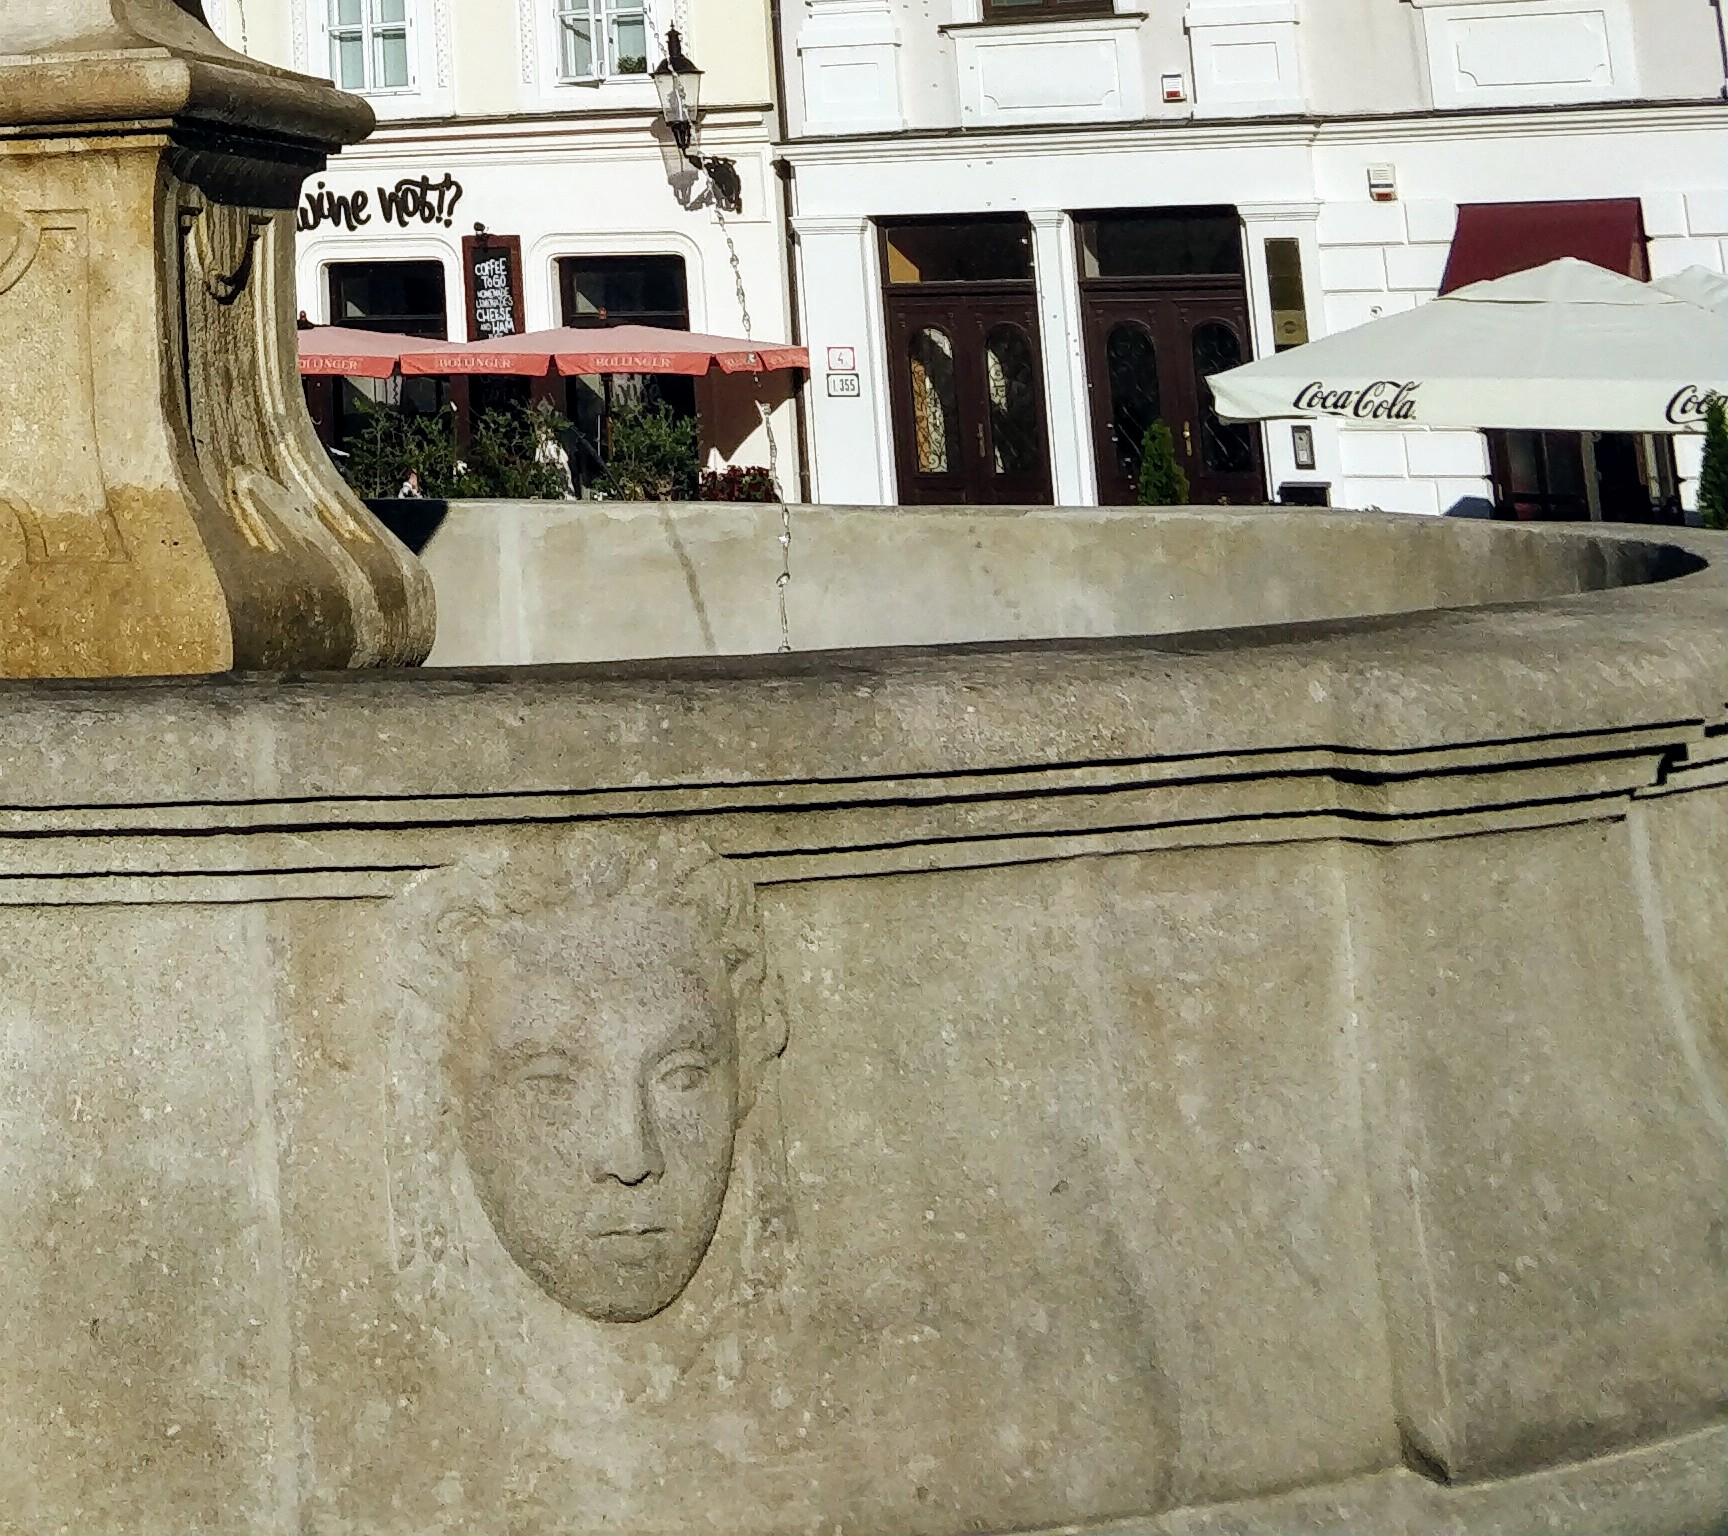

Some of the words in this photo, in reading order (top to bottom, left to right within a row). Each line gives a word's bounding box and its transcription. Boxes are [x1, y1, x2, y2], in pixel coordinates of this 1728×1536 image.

[474, 257, 508, 277] COFFEE
[475, 307, 512, 323] CHEESE
[298, 357, 359, 370] OLLINGER
